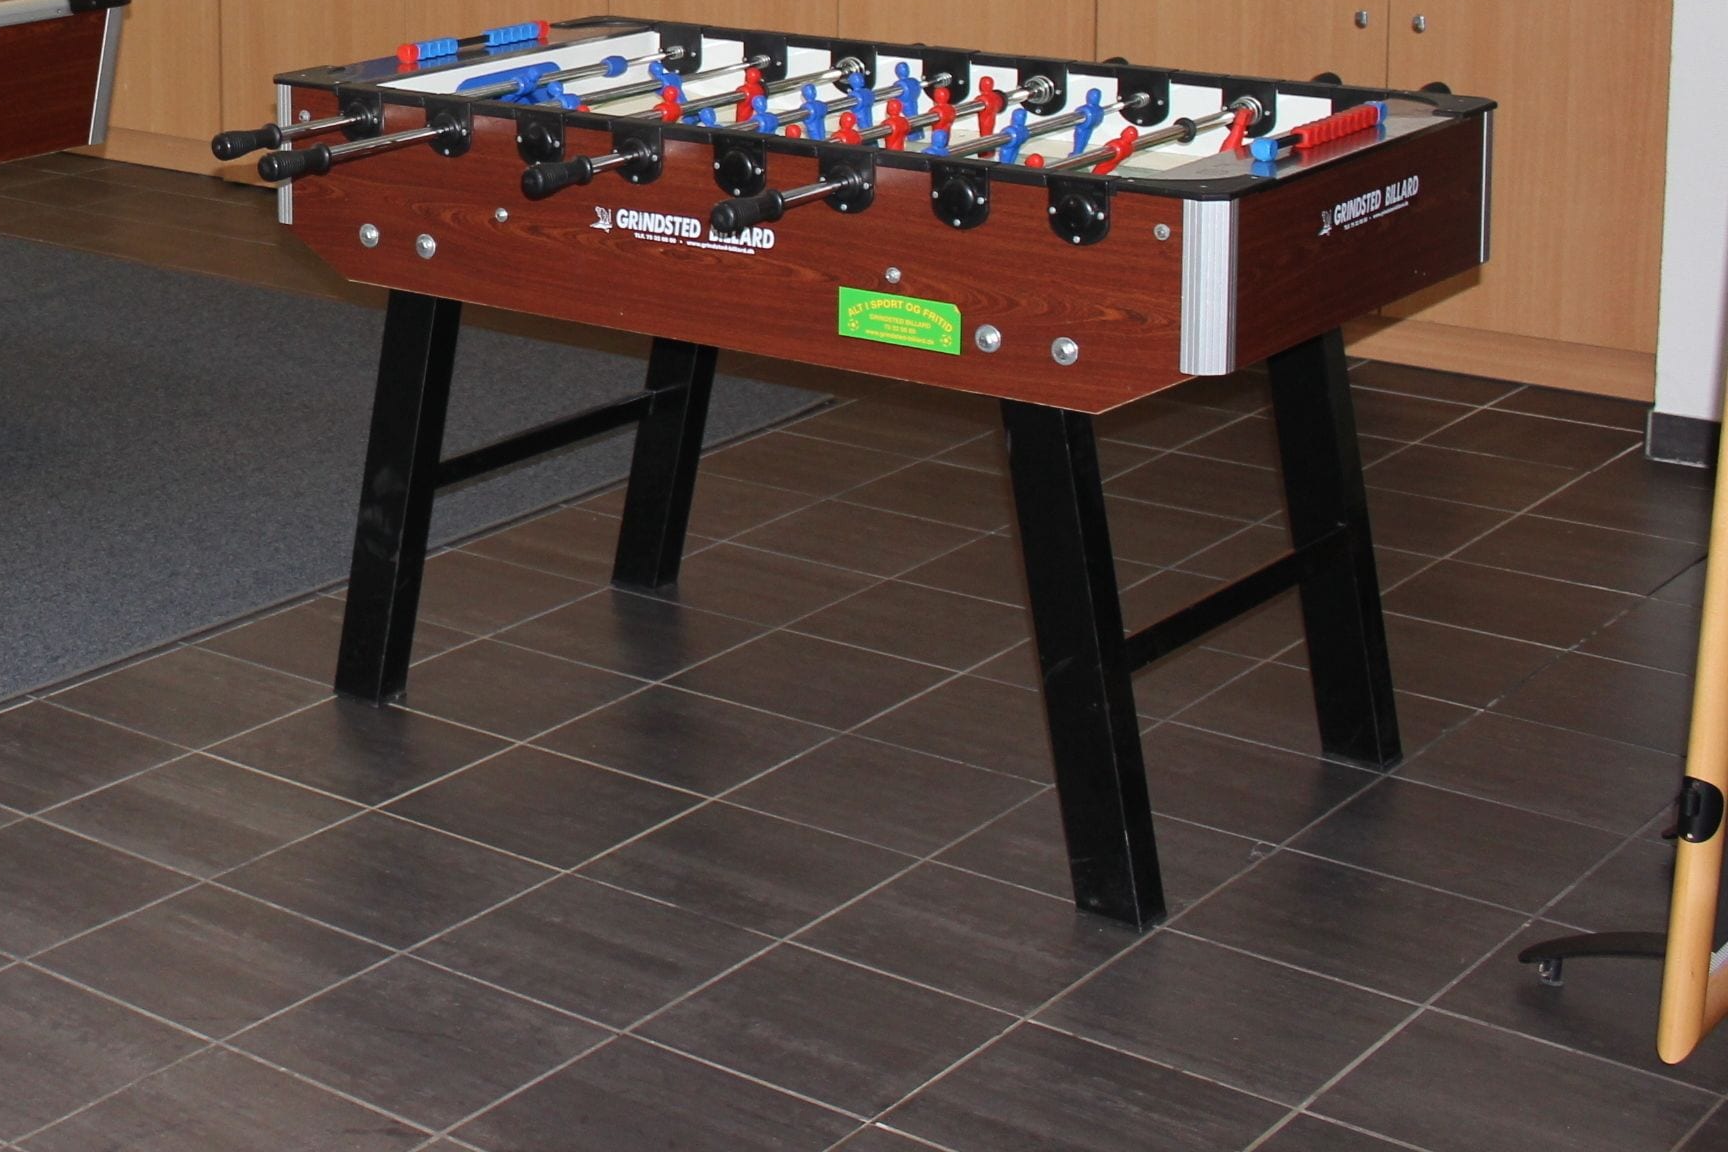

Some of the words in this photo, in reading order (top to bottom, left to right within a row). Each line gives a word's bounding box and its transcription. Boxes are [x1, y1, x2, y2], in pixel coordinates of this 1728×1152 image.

[1334, 189, 1382, 226] GRINDSTED
[1385, 175, 1419, 206] BILLARD
[616, 208, 702, 239] GRINDSTED
[847, 303, 864, 317] ALT
[870, 299, 904, 310] SPORT
[905, 302, 922, 315] OG
[922, 308, 954, 333] FRITID
